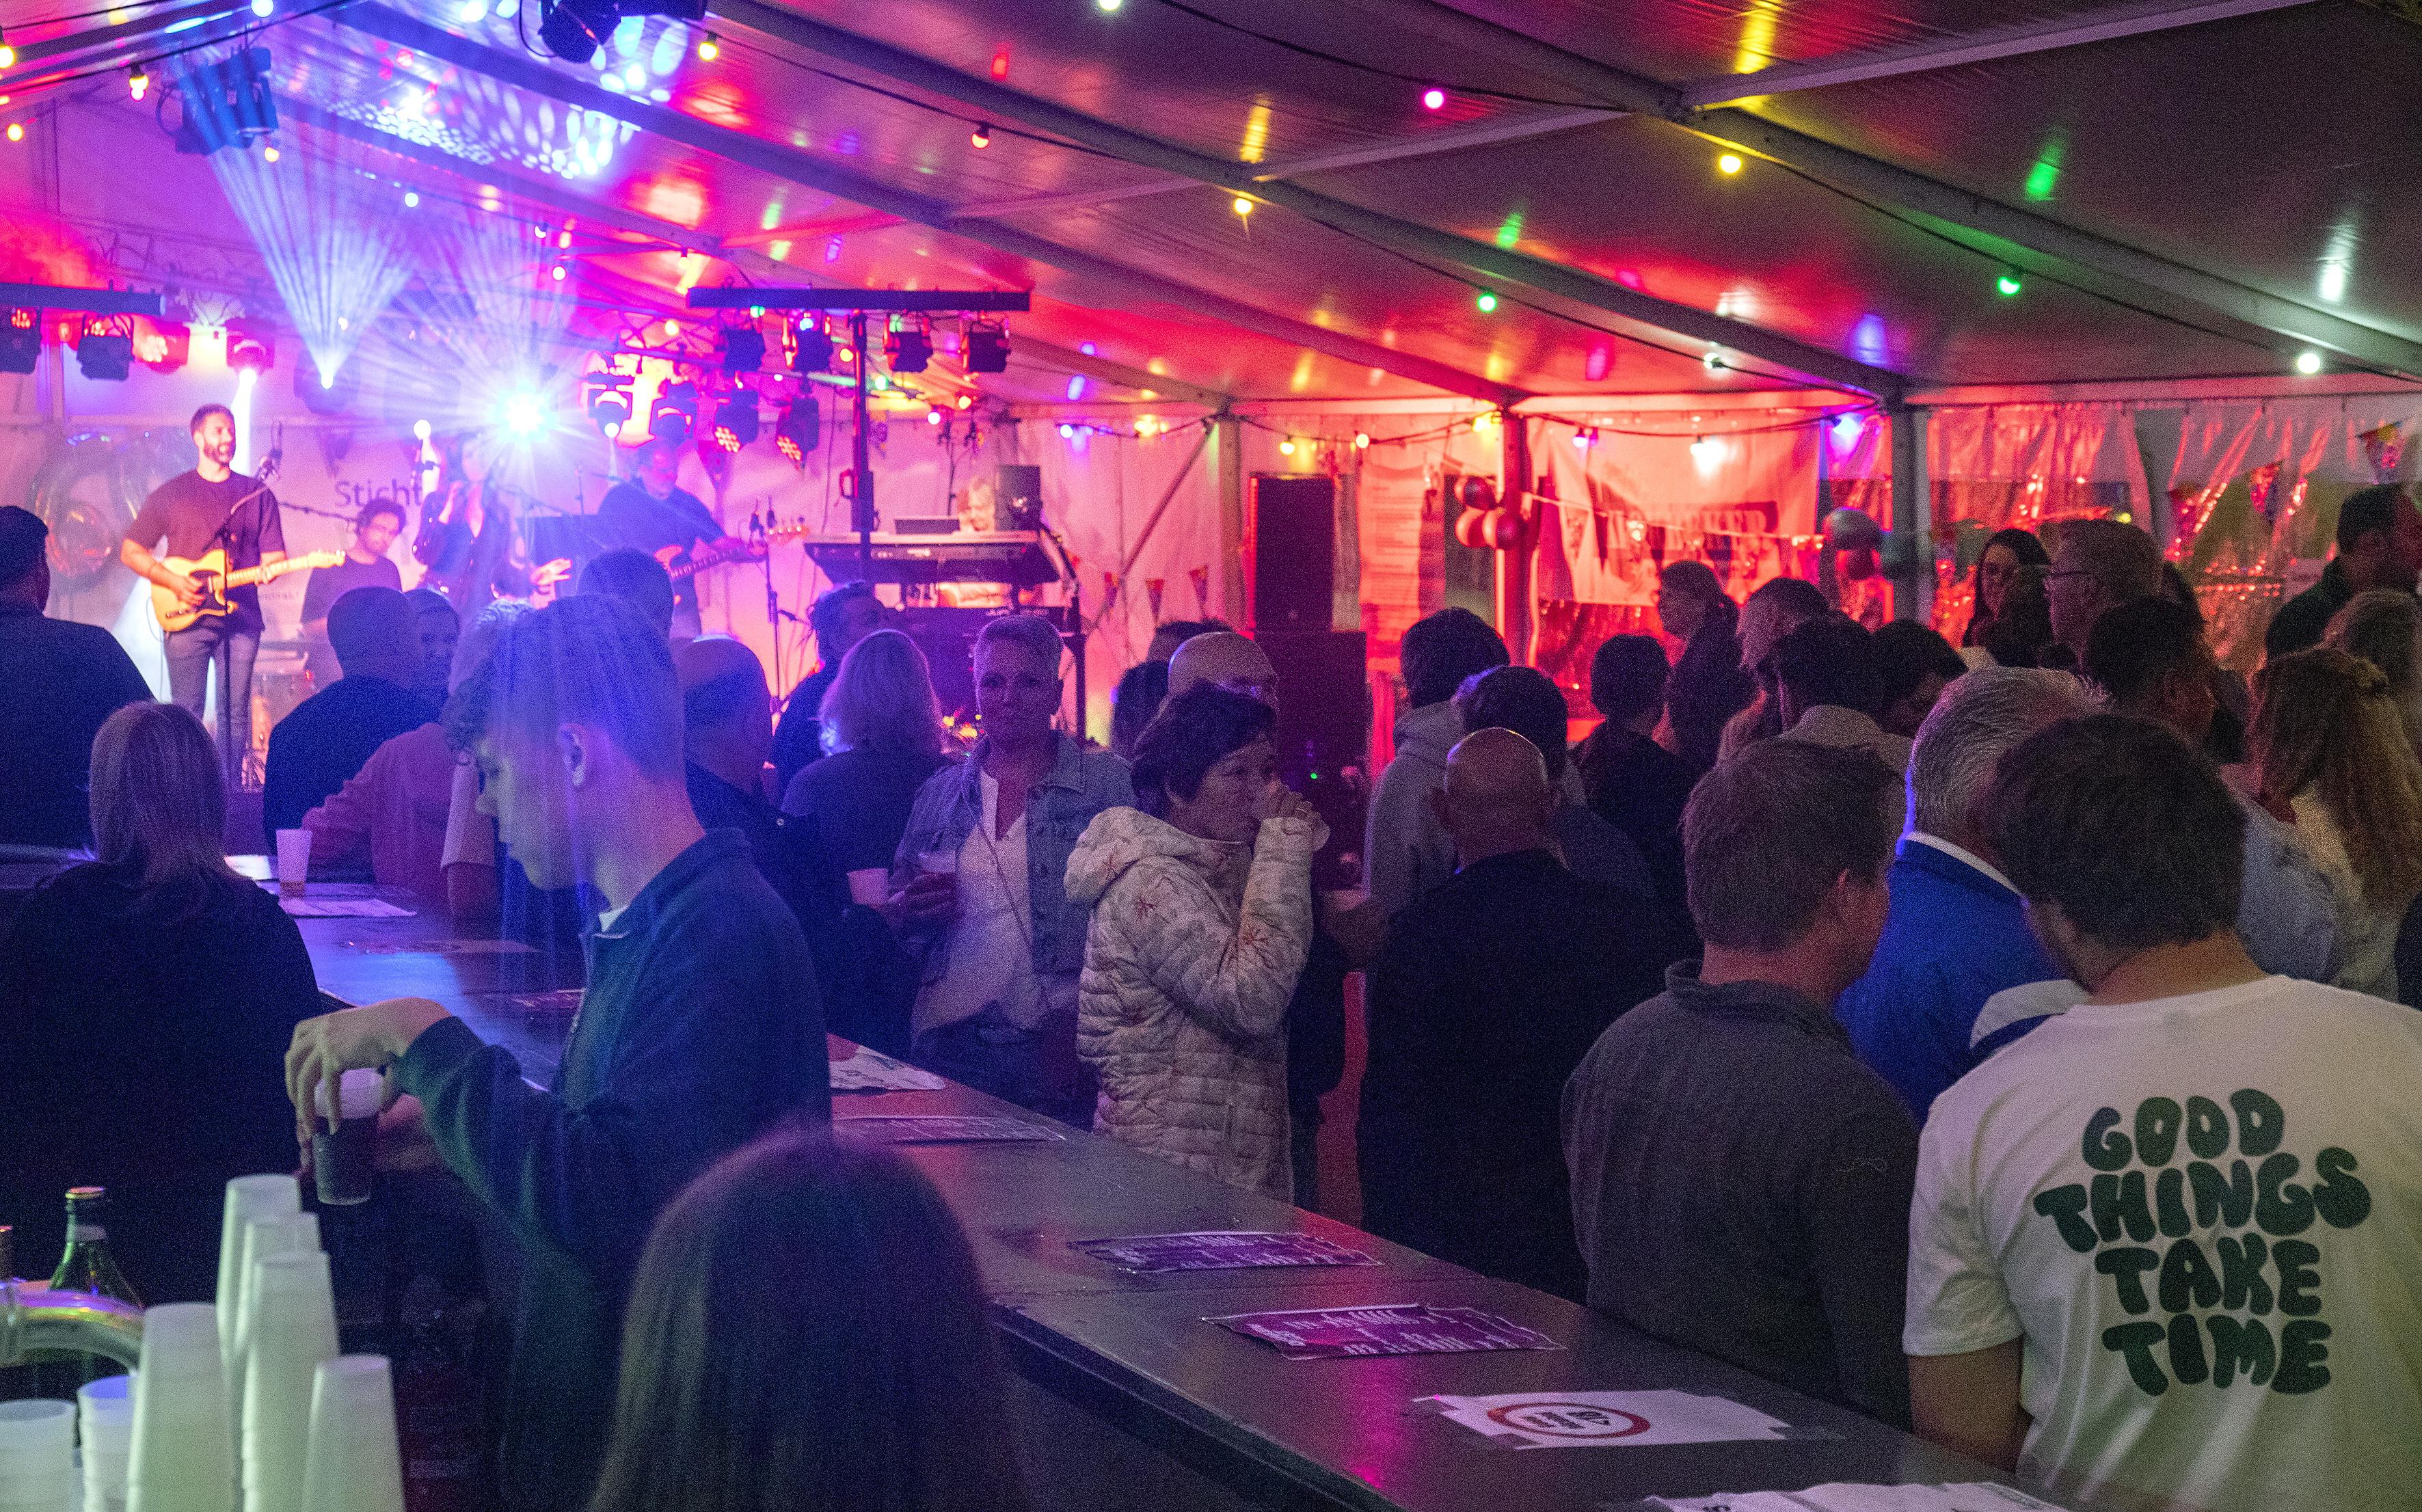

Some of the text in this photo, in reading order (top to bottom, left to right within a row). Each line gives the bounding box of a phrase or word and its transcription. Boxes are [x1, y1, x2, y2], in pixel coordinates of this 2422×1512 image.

[2082, 1088, 2285, 1172] GOOD
[2033, 1147, 2372, 1254] THINGS
[2094, 1232, 2323, 1317] TAKE
[2101, 1313, 2332, 1396] TIME
